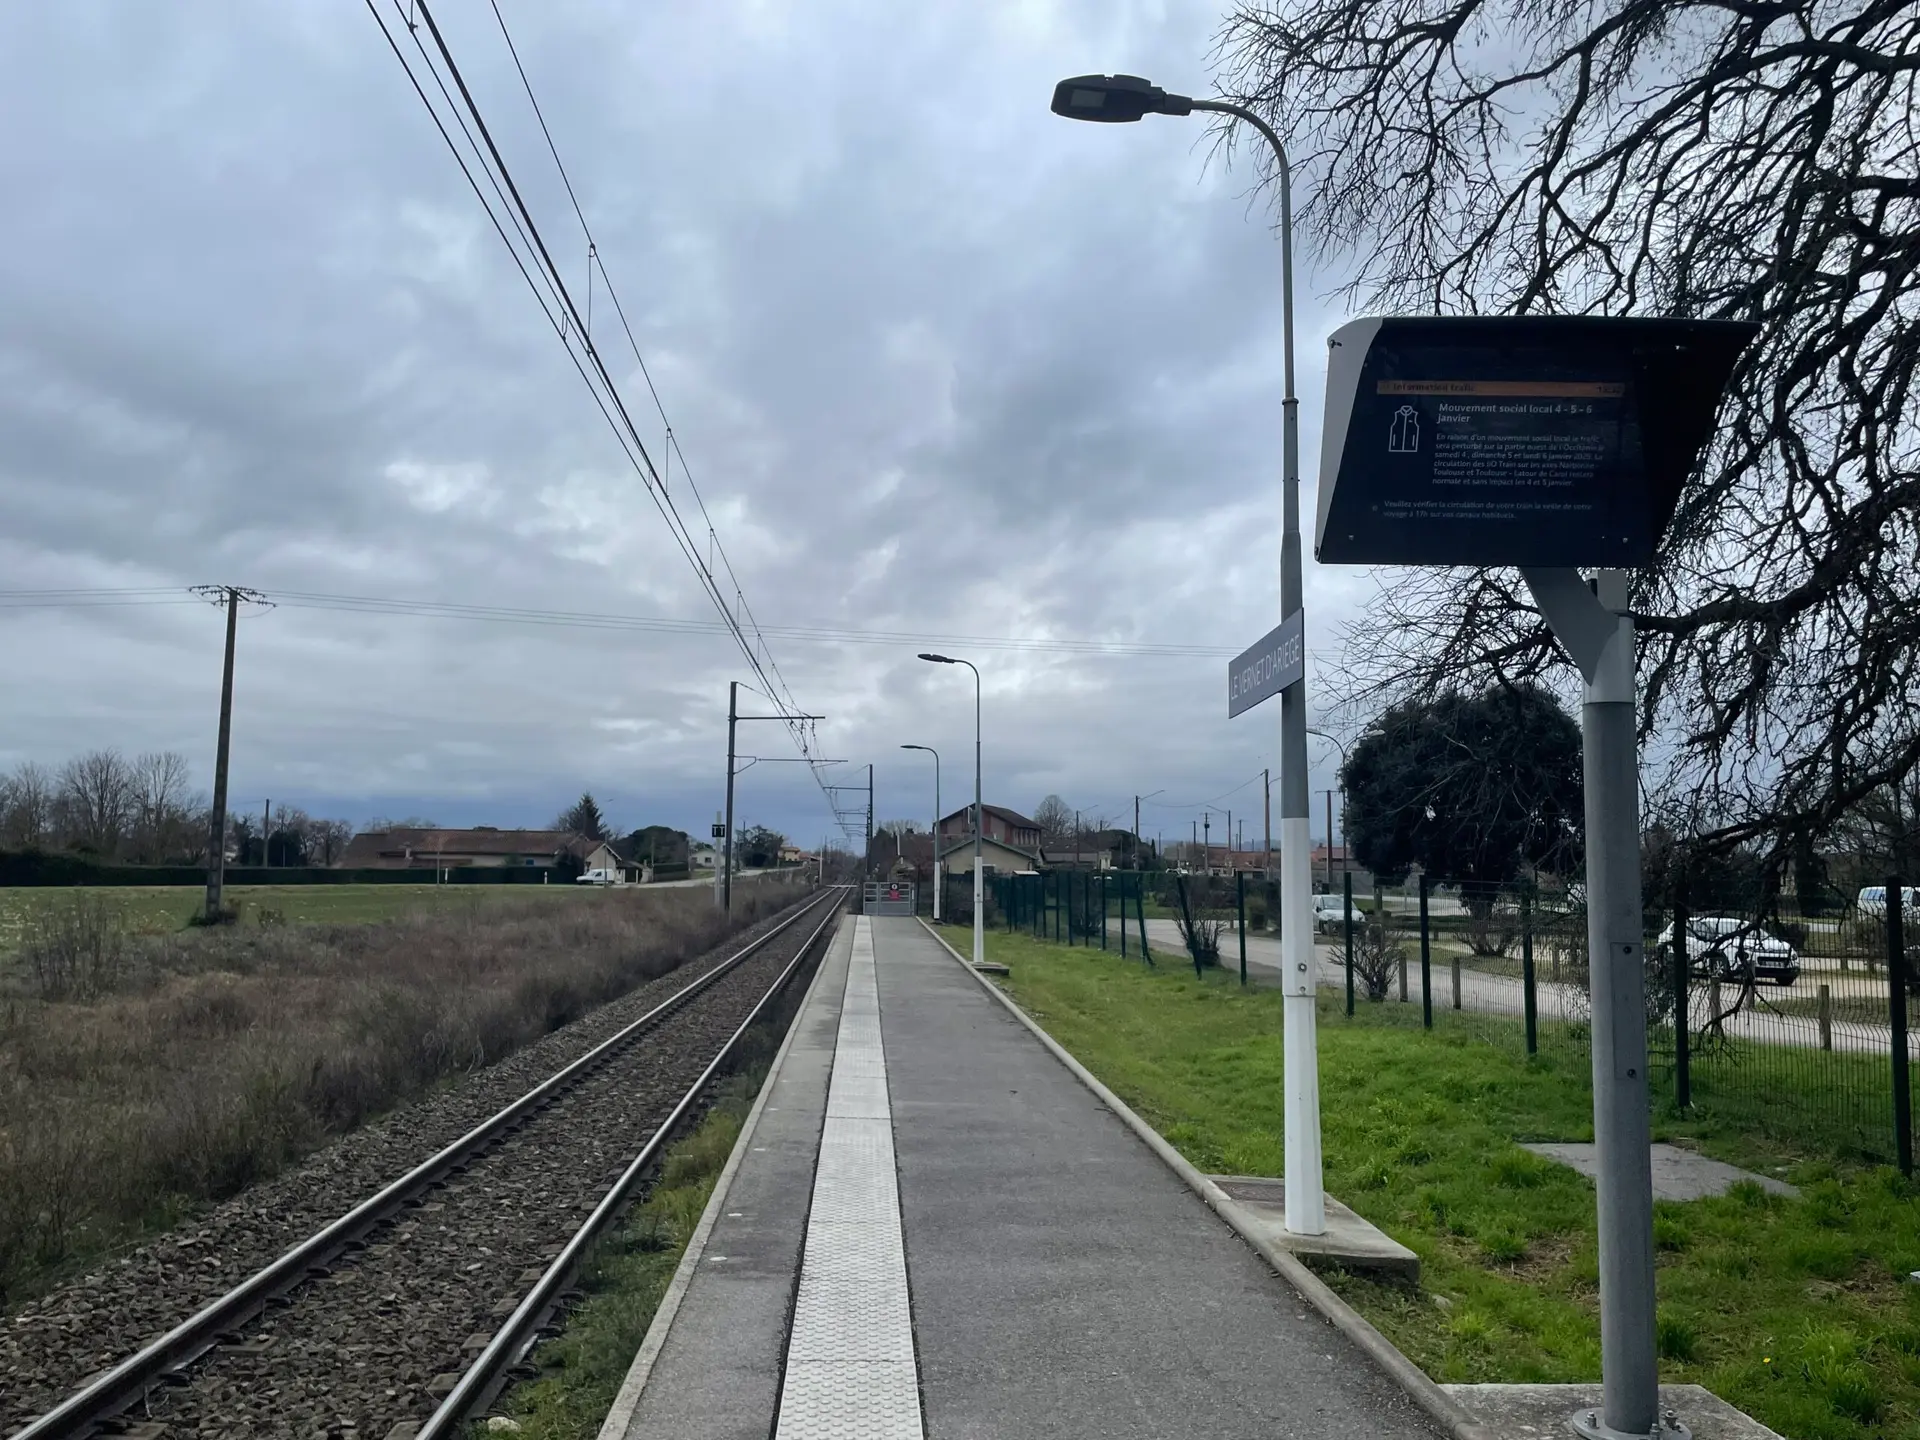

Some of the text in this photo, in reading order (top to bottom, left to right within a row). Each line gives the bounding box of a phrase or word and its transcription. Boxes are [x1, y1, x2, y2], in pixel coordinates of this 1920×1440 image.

[1439, 403, 1496, 413] Mouvement
[1499, 404, 1526, 414] social
[1529, 404, 1552, 414] local
[1554, 404, 1561, 414] 4
[1570, 405, 1576, 414] 5
[1586, 405, 1592, 414] 6
[1436, 414, 1471, 424] janvier
[1505, 444, 1525, 452] partie
[1230, 675, 1238, 700] LE
[1239, 659, 1264, 695] VERNET
